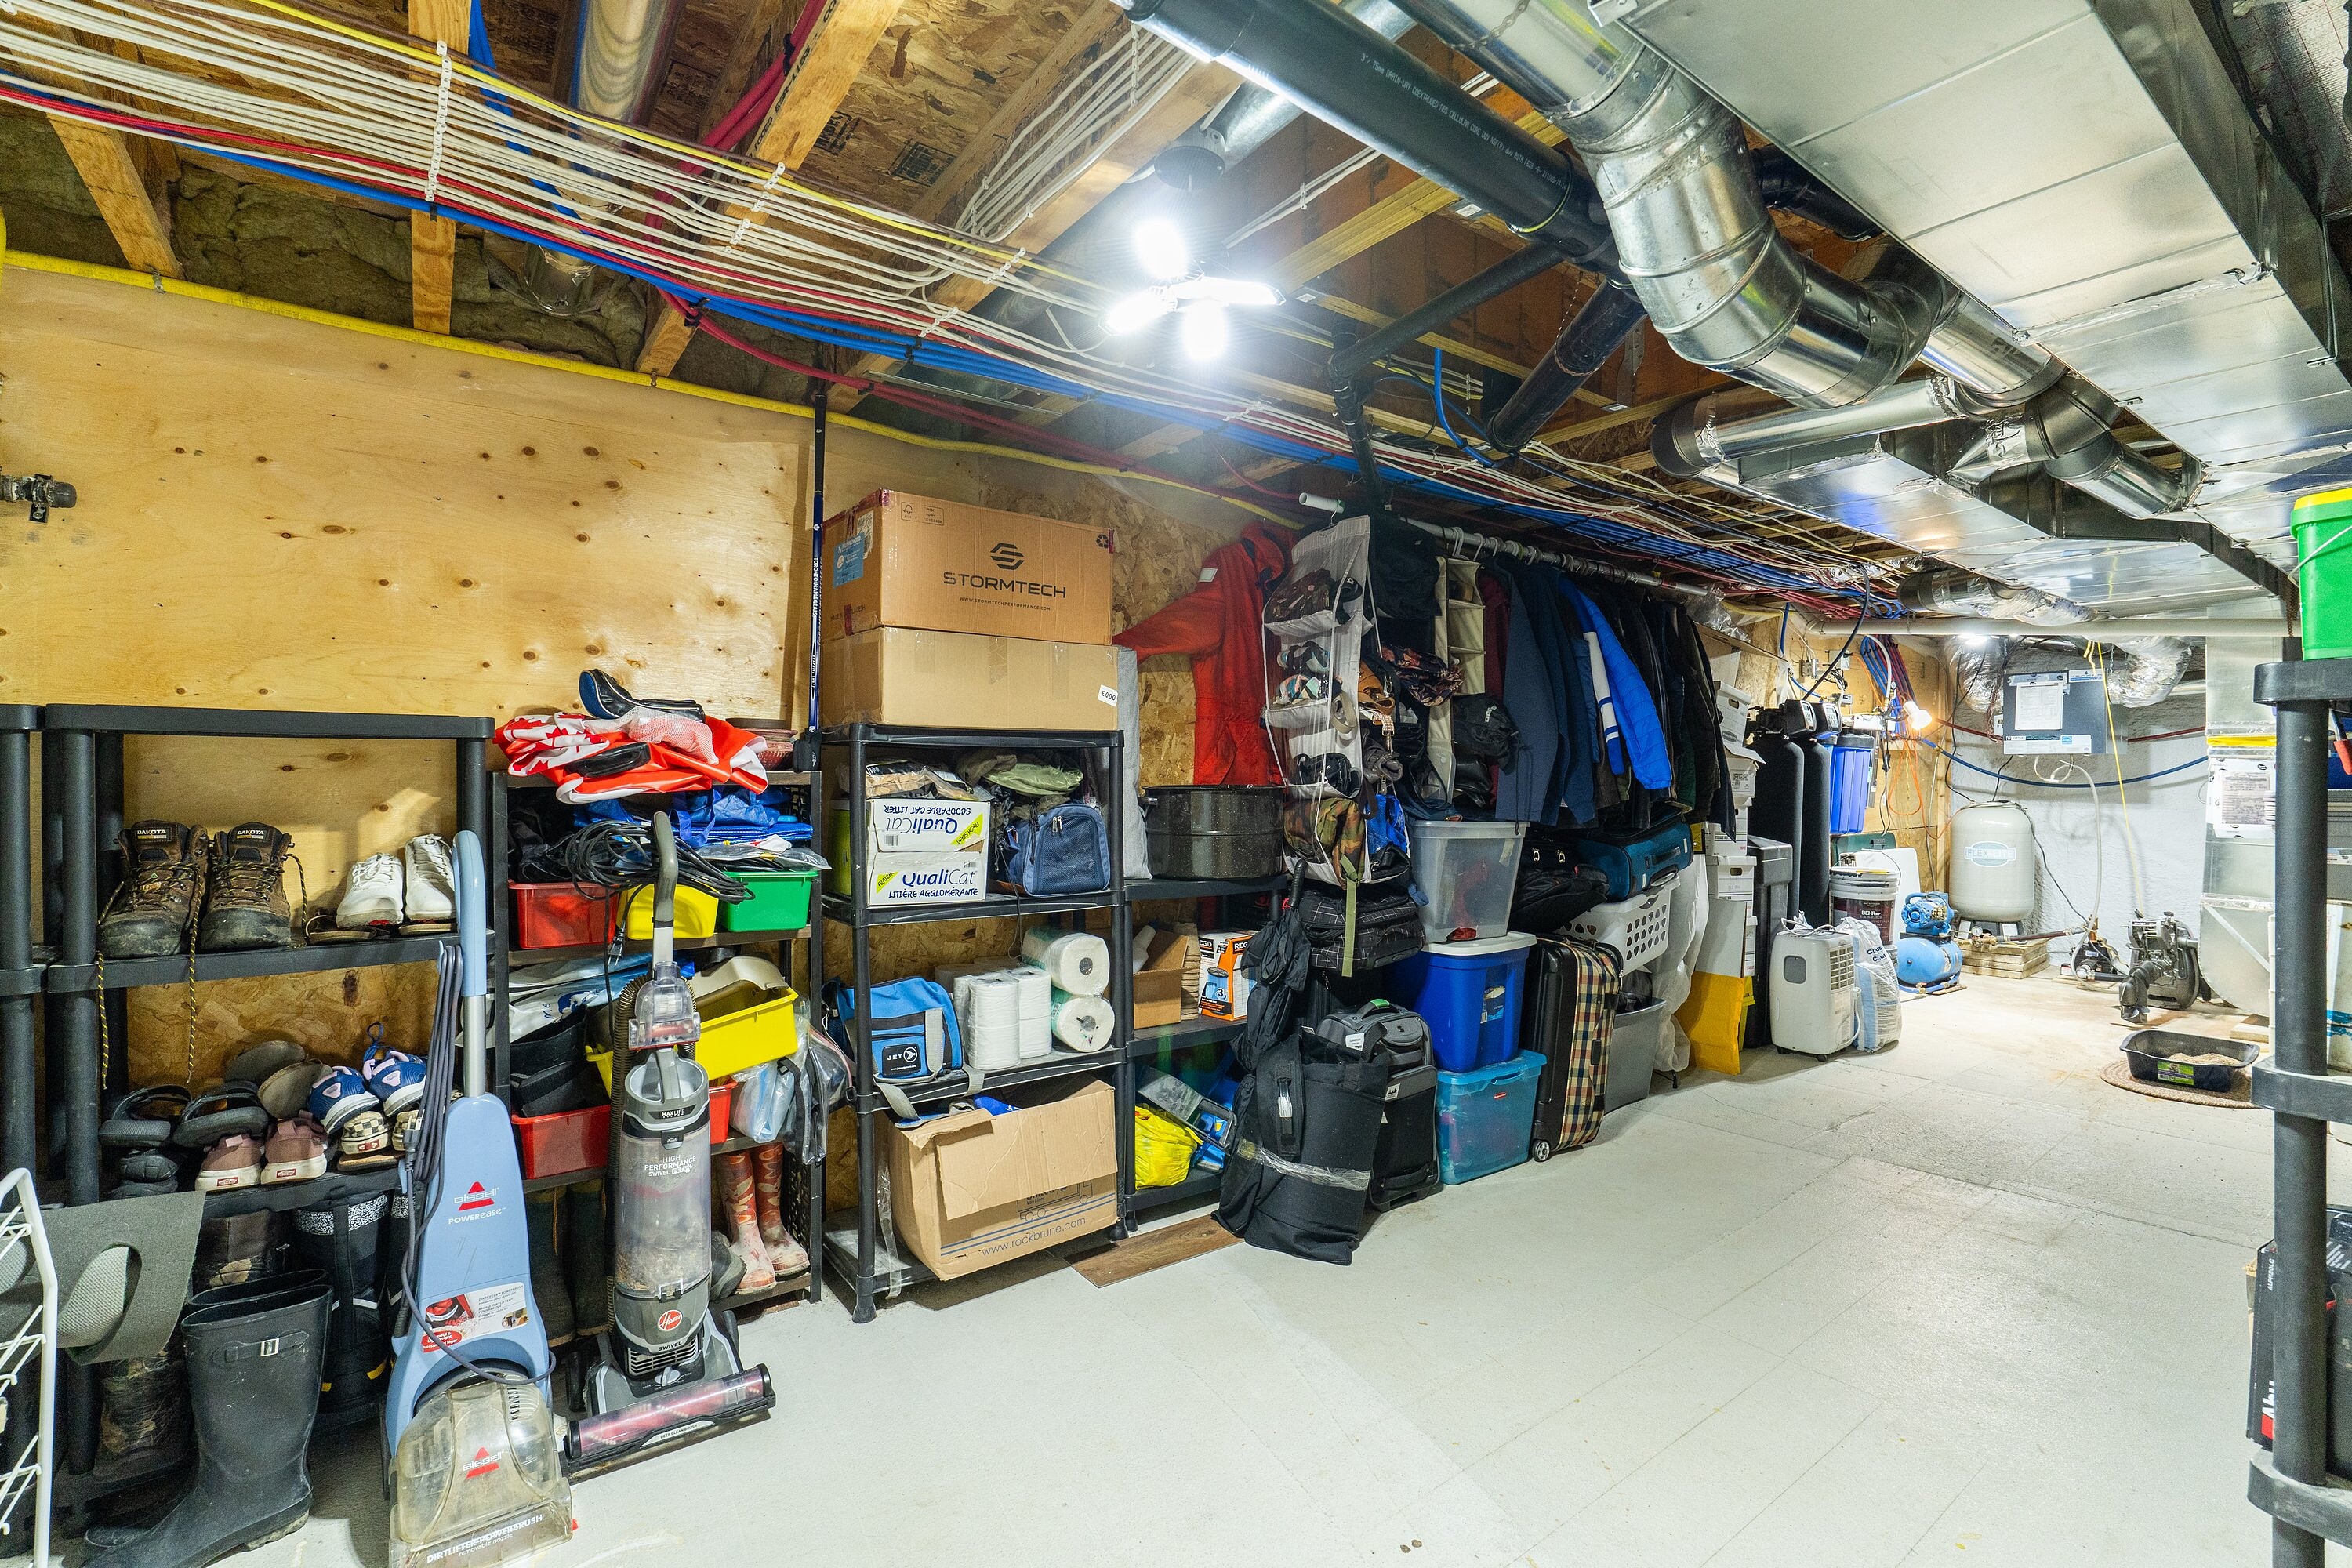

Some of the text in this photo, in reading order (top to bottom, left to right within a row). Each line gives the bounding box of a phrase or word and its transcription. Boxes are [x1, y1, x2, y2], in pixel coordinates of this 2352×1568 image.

[943, 572, 1066, 599] STORMTECH
[960, 597, 1051, 612] WWW.STORMTECHPERFORMANCE.COM
[884, 804, 971, 815] SCOOPABLE CAT LITTER
[887, 817, 958, 834] QualiCat
[902, 869, 975, 887] QualiCat
[888, 887, 978, 898] LITIÈRE AGGLOMÉRANTE
[644, 1156, 697, 1171] PERFORMANCE
[981, 1217, 1086, 1256] www.rockbrune.com
[659, 1341, 682, 1352] SWIVEL
[459, 1541, 492, 1557] removable
